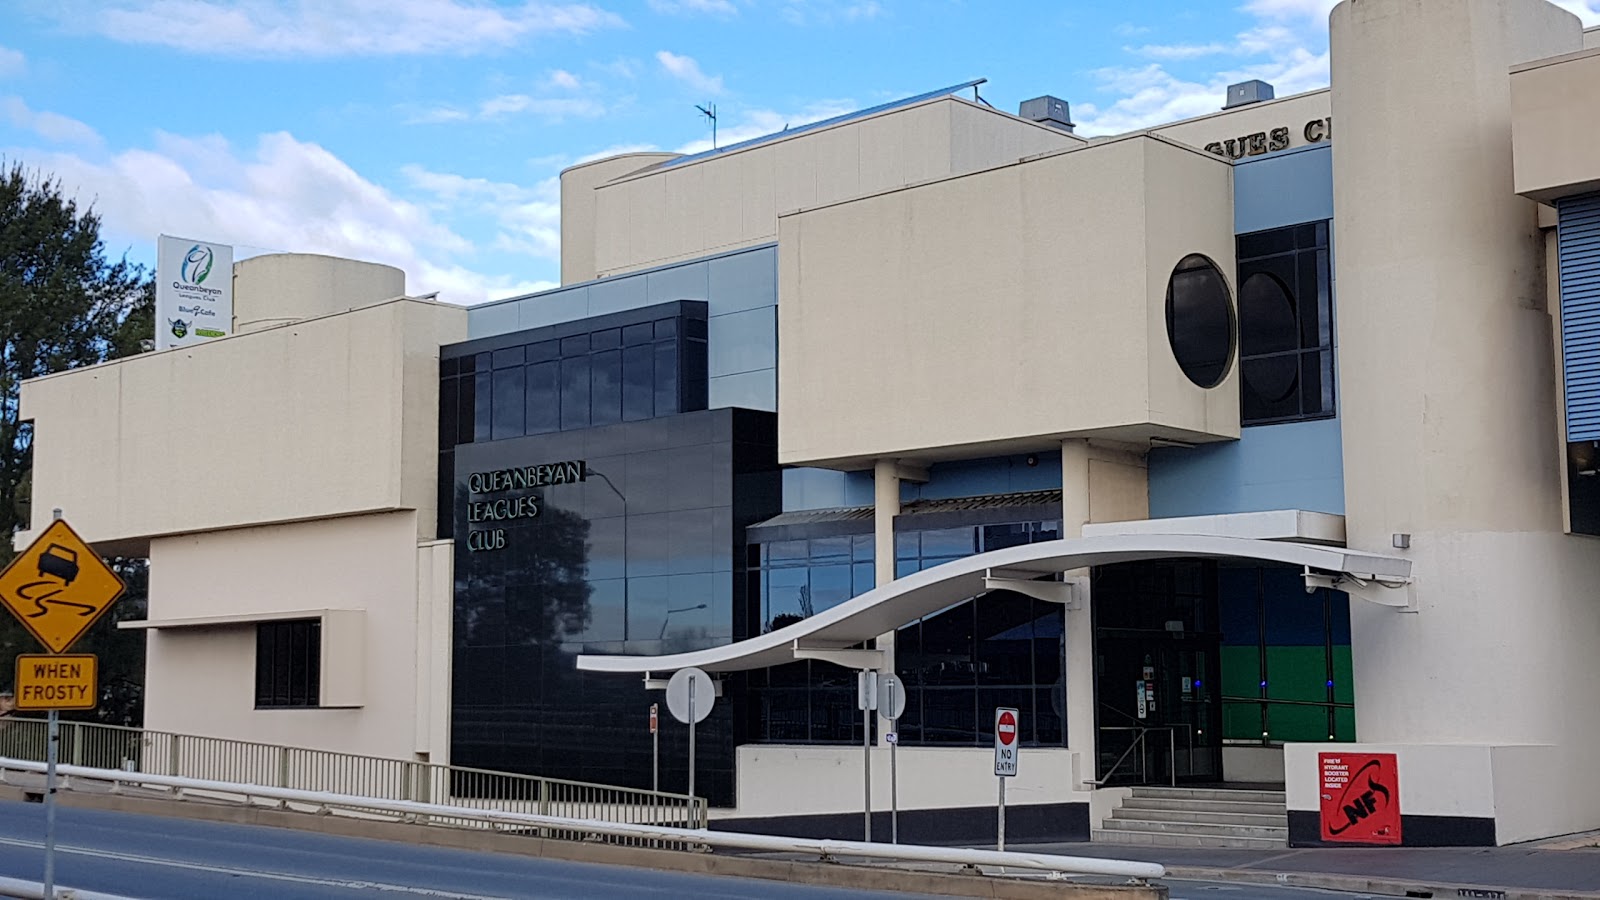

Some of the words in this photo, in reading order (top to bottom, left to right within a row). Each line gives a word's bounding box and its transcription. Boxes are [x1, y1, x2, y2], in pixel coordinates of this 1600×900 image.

[172, 281, 222, 295] Queanbeyan
[468, 460, 585, 493] QUEANBEYAN
[467, 496, 538, 522] LEAGUES
[467, 529, 506, 552] CLUB
[33, 664, 81, 678] WHEN
[23, 685, 88, 700] FROSTY
[1001, 749, 1012, 759] NO
[996, 761, 1015, 772] ENTRY
